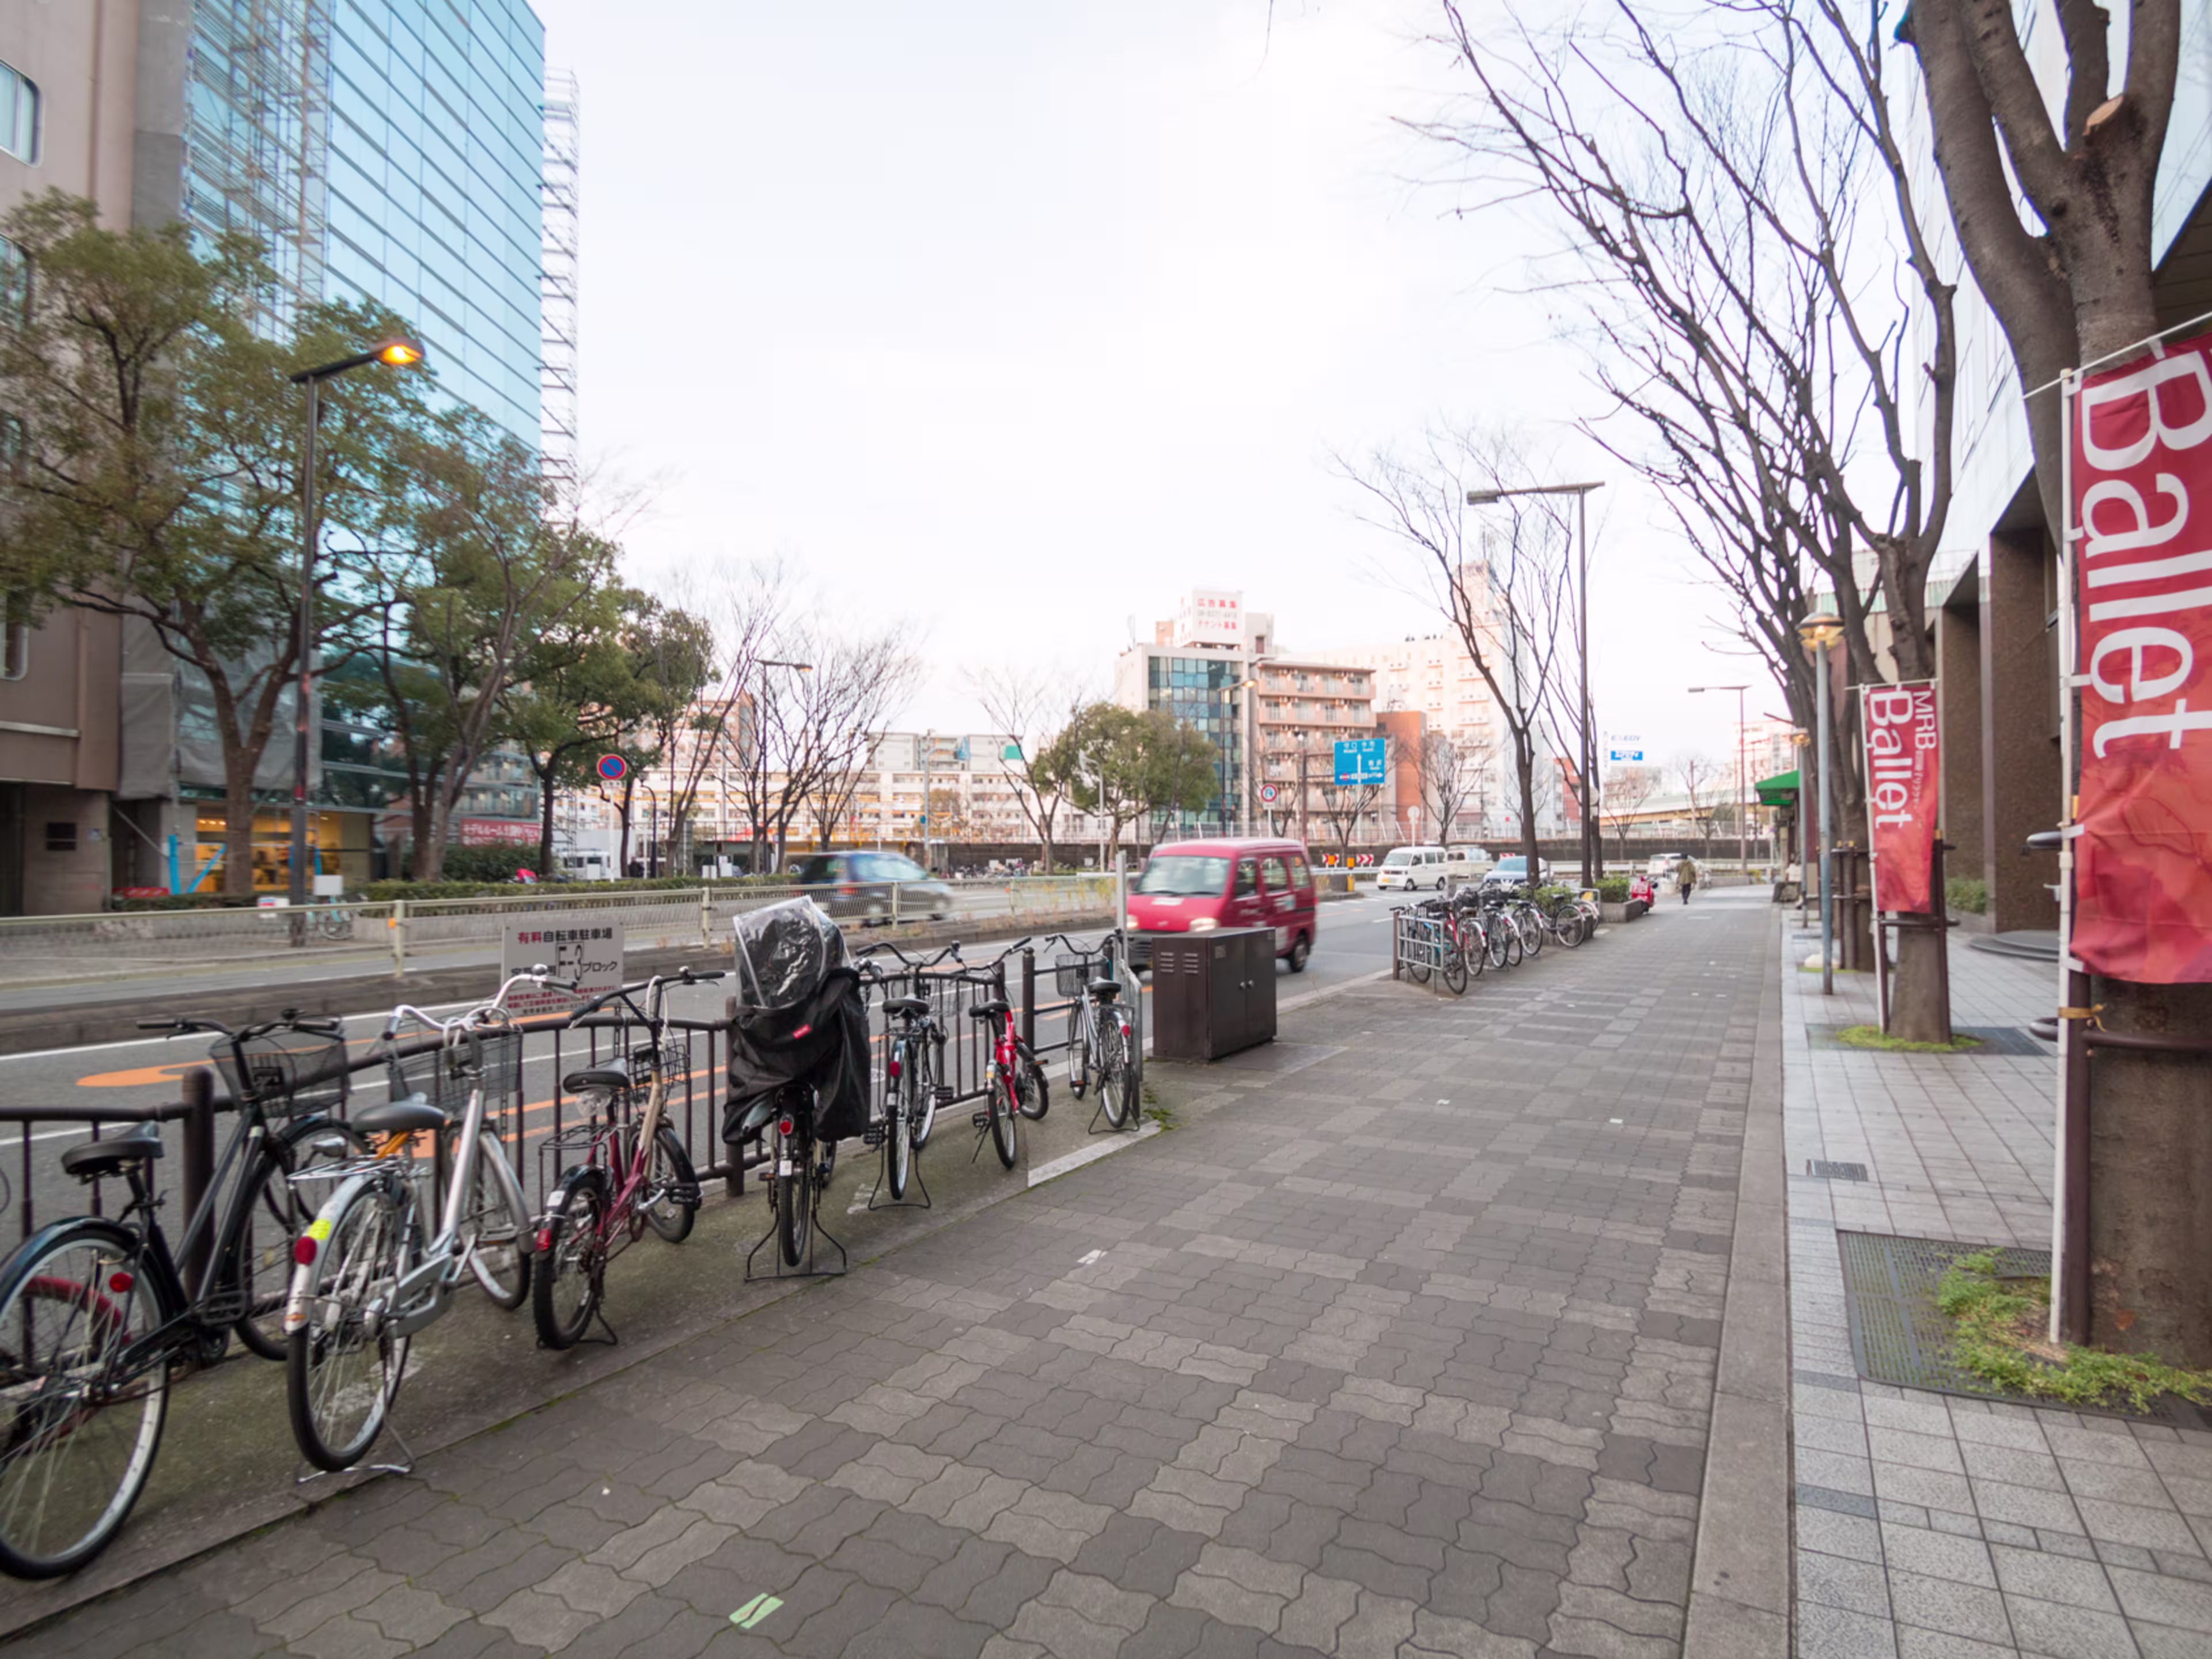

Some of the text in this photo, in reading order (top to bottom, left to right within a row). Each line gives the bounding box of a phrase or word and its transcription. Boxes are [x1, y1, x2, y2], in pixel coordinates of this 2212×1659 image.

[2082, 350, 2212, 759] Ballet
[1914, 691, 1937, 749] MRB
[1870, 691, 1913, 828] Ballet
[517, 928, 612, 944] 有料自転車駐車場
[584, 961, 618, 972] ブロック
